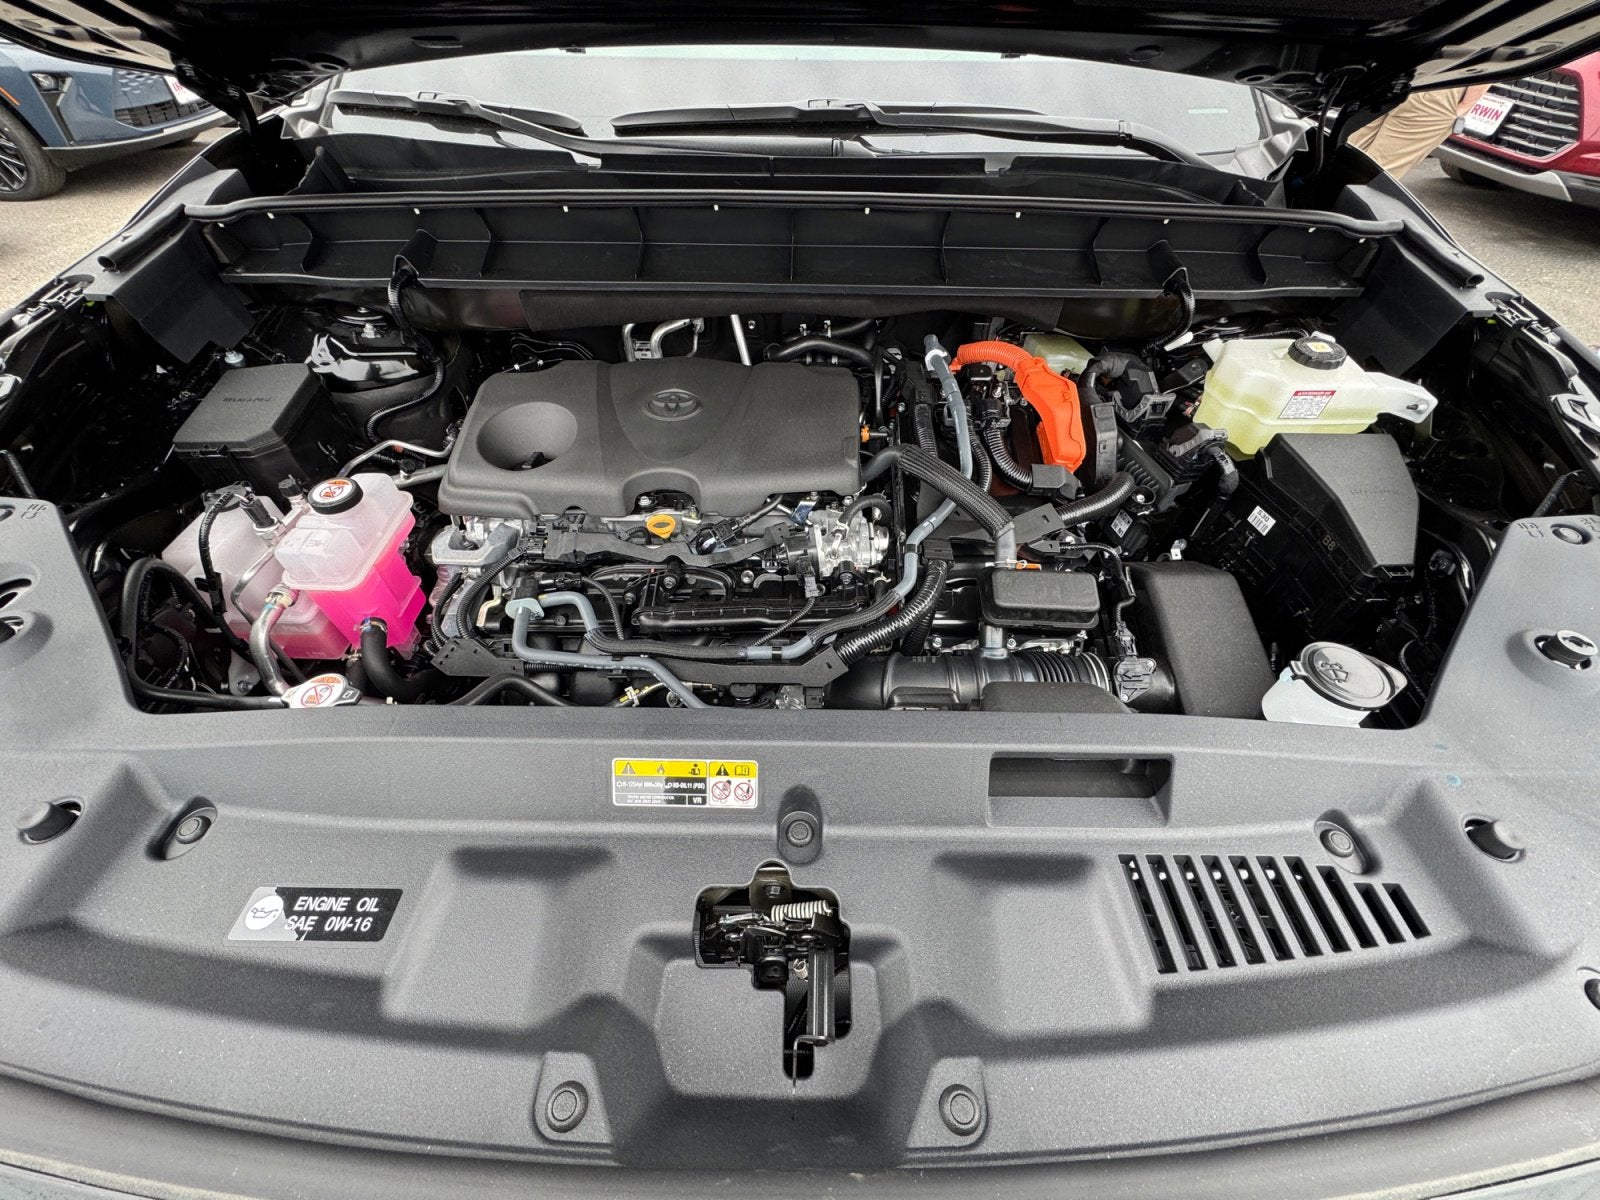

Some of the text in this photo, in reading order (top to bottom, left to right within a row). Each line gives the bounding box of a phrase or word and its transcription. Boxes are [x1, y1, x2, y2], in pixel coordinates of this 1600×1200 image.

[1470, 103, 1504, 121] RWIN
[692, 796, 702, 804] VR
[293, 896, 380, 912] ENGINE OIL
[284, 916, 373, 932] SAE 0W-16
